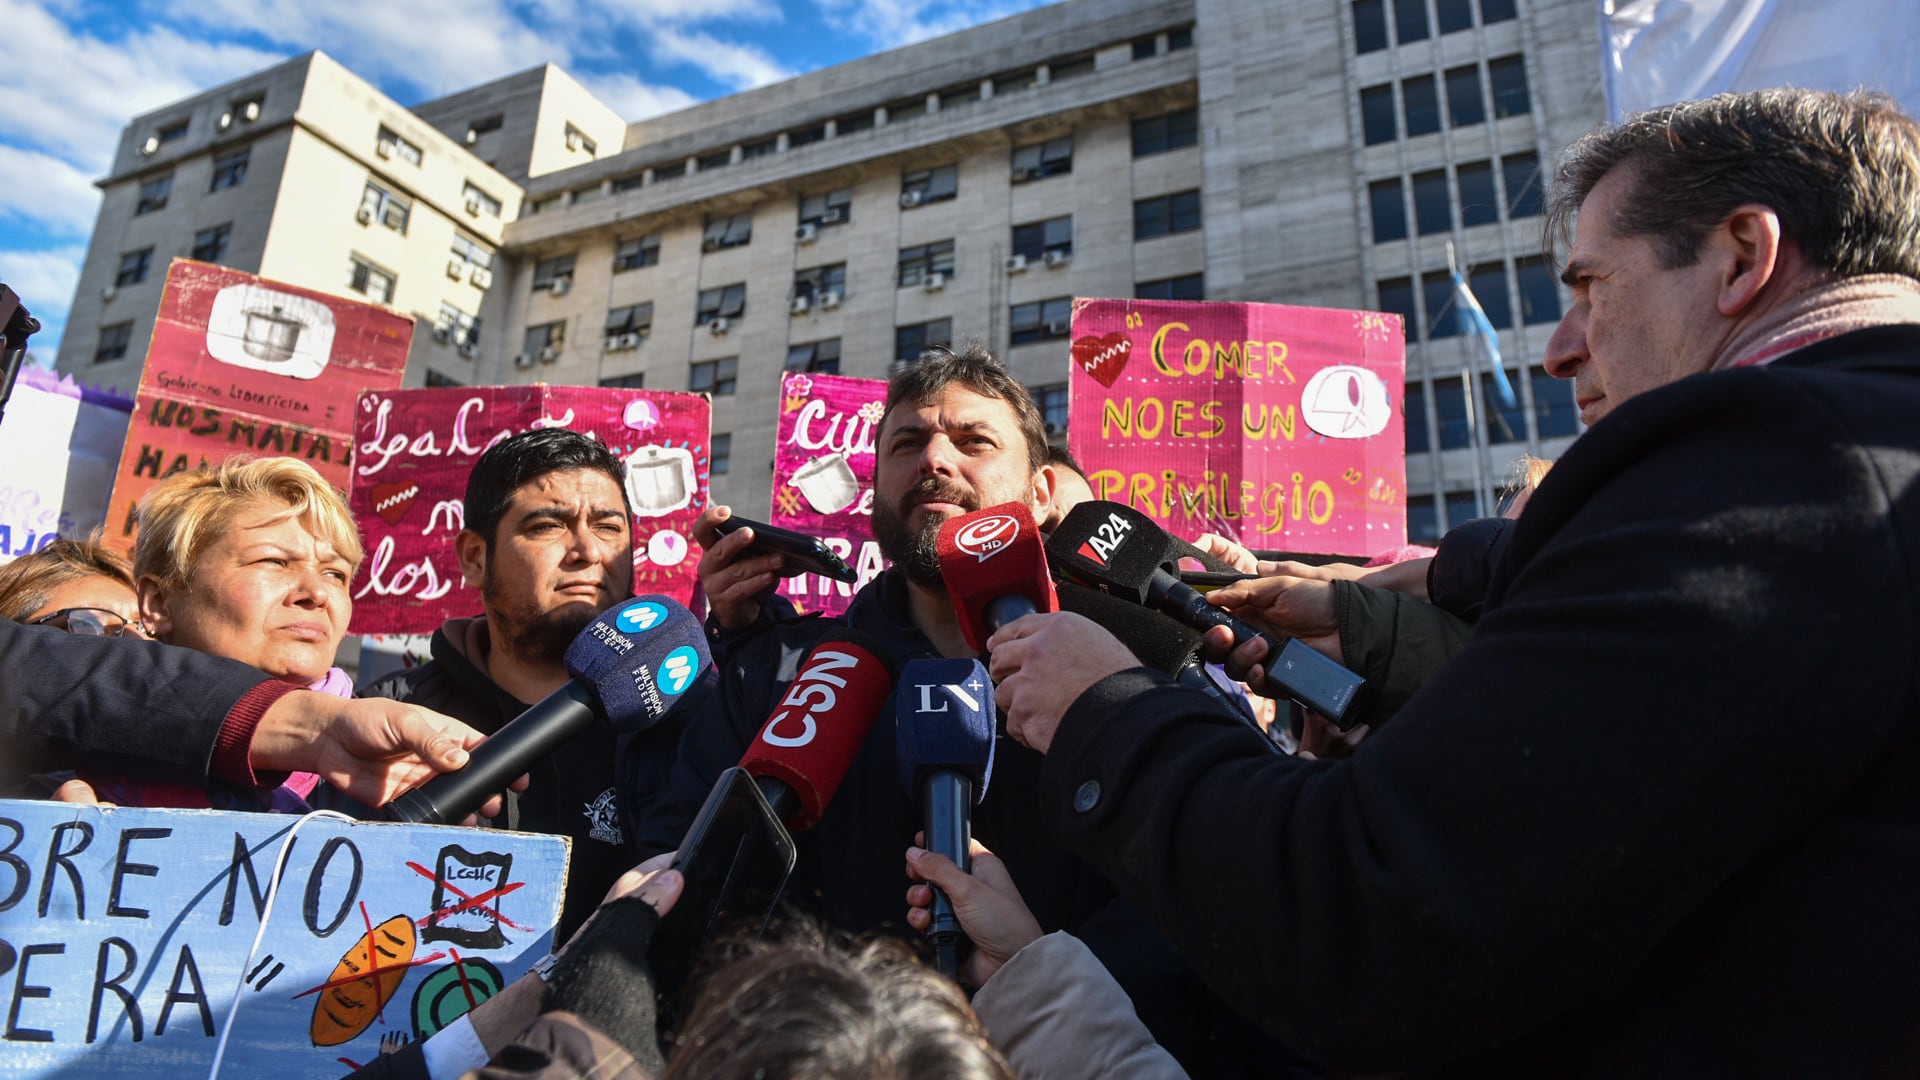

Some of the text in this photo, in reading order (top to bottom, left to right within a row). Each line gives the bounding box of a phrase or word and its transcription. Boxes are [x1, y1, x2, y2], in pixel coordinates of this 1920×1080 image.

[1102, 397, 1296, 441] NO ES UN
[981, 539, 1002, 551] HD
[1089, 512, 1133, 561] A24
[355, 535, 453, 601] los
[588, 626, 626, 657] FEDERAL
[595, 620, 635, 651] MULTIVISIÓN
[631, 669, 656, 719] FEDERAL
[638, 663, 664, 715] MULTIVISIÓN
[762, 651, 859, 747] C5N
[218, 832, 363, 938] NO
